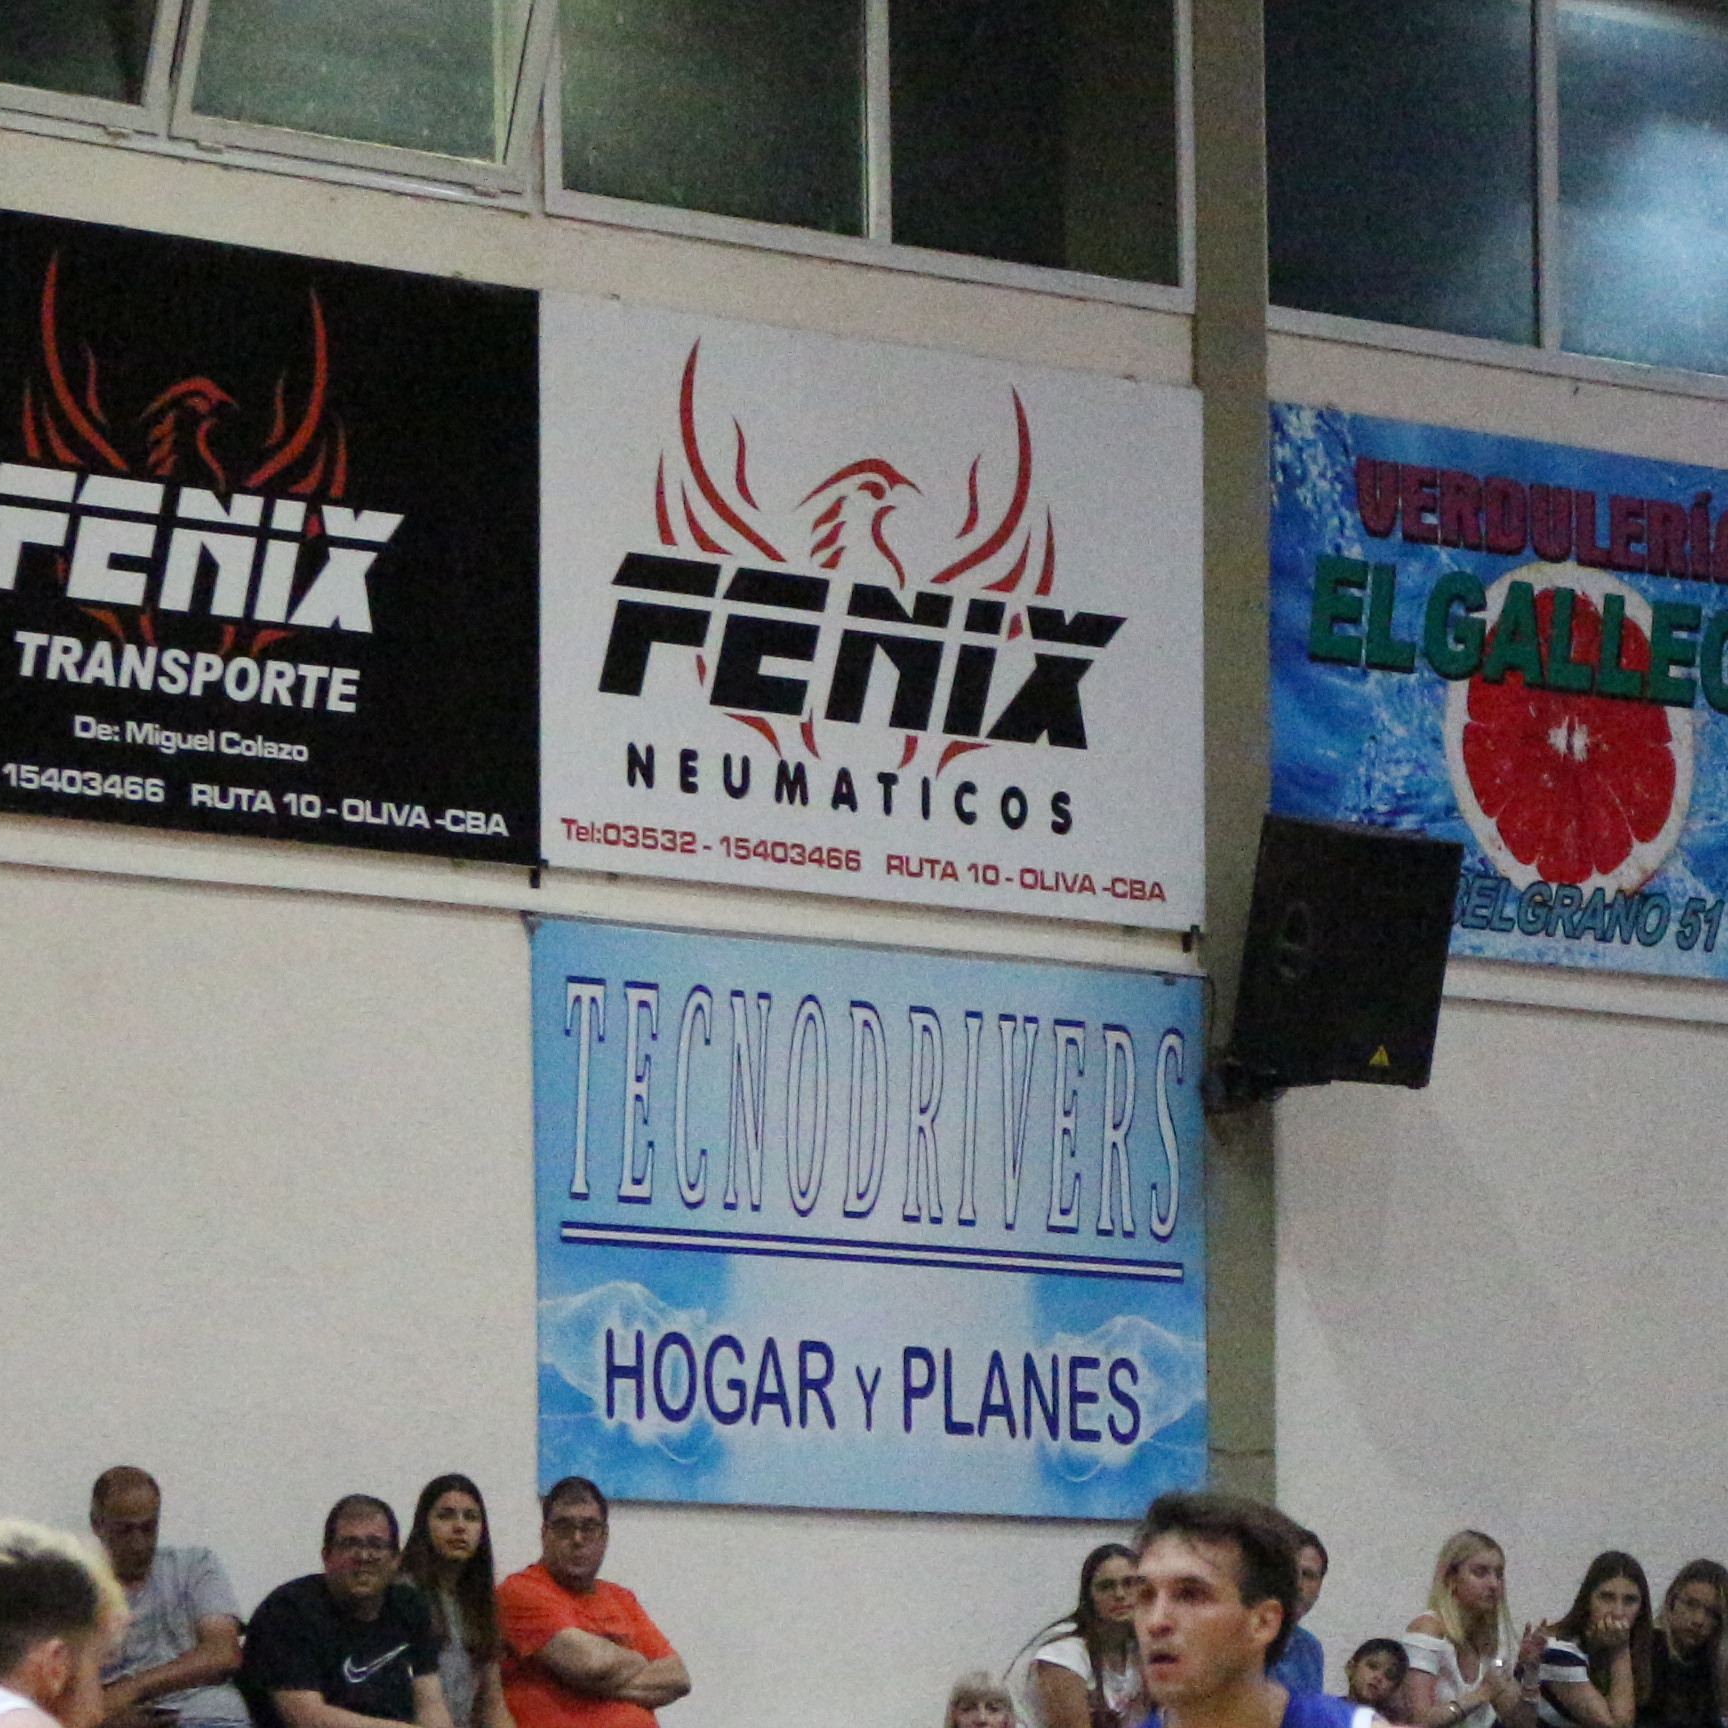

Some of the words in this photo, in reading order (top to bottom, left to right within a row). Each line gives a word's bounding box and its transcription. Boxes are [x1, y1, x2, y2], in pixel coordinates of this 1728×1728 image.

[14, 630, 360, 714] TRANSPORTE
[599, 551, 1127, 750] FENIX
[74, 716, 120, 743] De:
[126, 720, 215, 755] Miguel
[223, 730, 309, 763] Colazo
[3, 763, 165, 804] 15403466
[191, 784, 276, 817] RUTA
[283, 792, 321, 820] 10
[342, 799, 430, 831] OLIVA
[627, 743, 1072, 835] NEUMATICOS
[561, 818, 696, 855] Tel:03532
[720, 836, 861, 873] 15403466
[886, 854, 959, 882] RUTA
[966, 862, 999, 886] 10
[1019, 867, 1096, 896] OLIVA
[1676, 896, 1725, 952] 51
[565, 975, 1184, 1243] TECNODRIVERS
[605, 1328, 835, 1430] HOGAR
[902, 1345, 1141, 1445] PLANES
